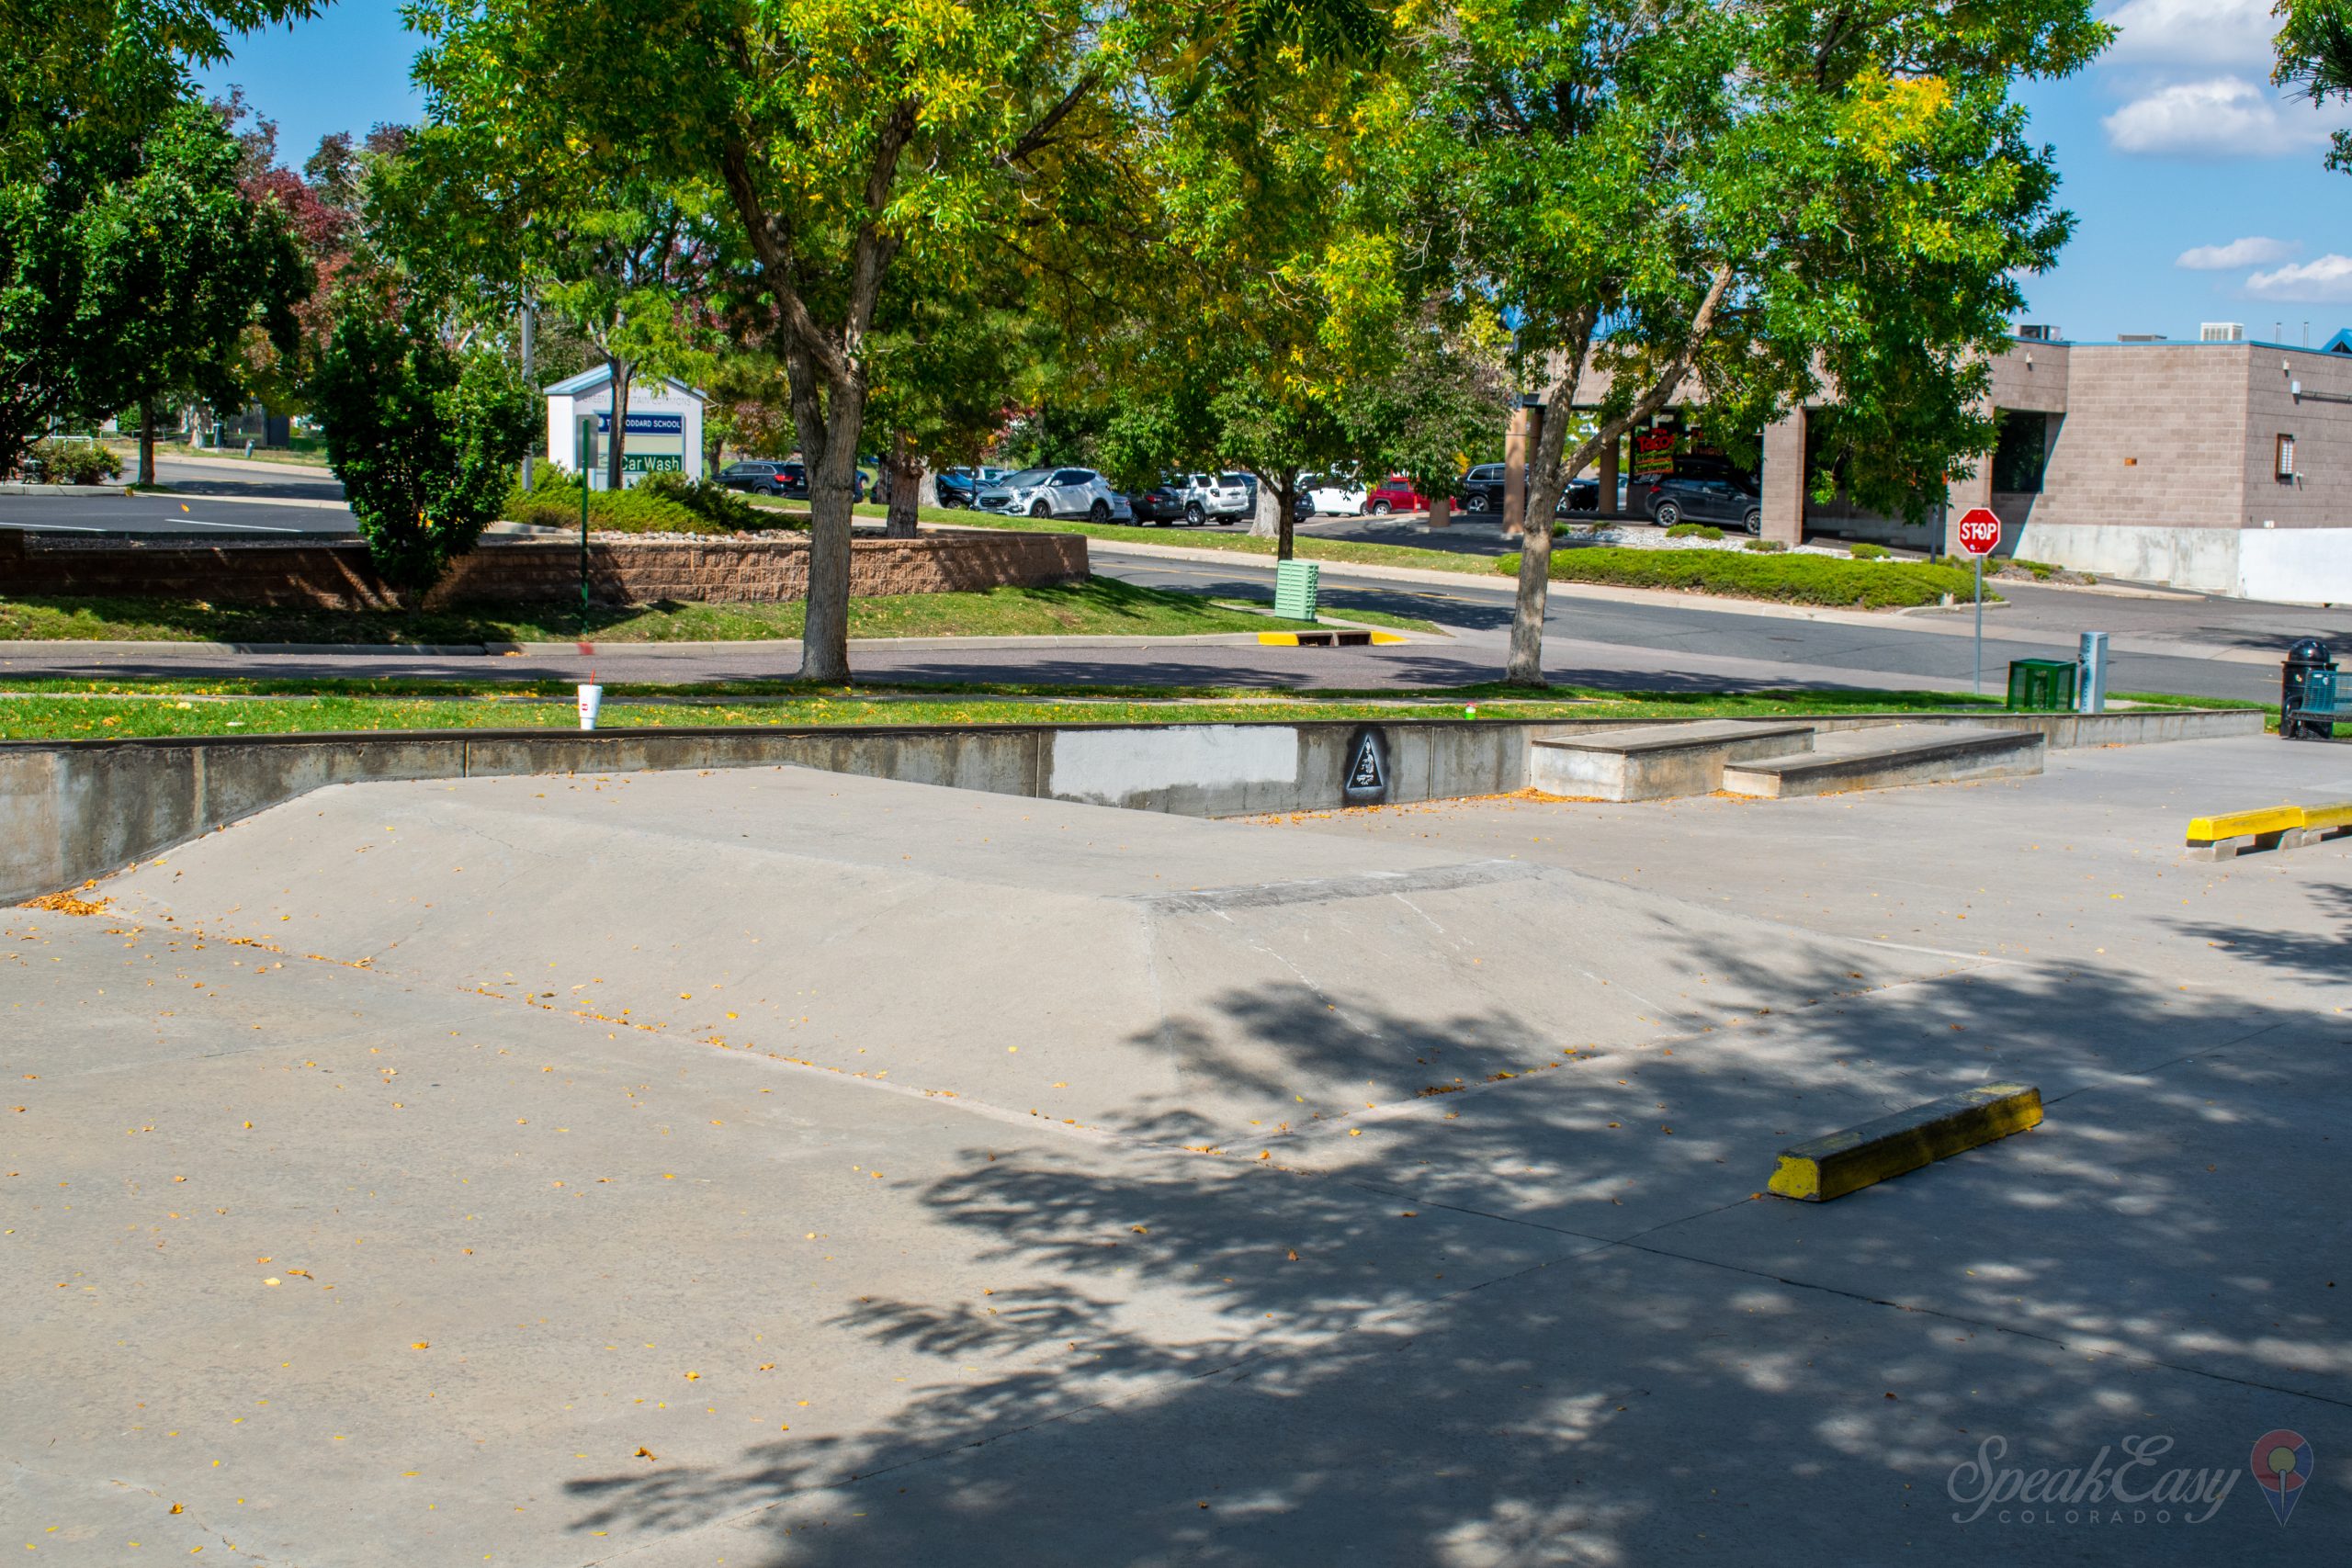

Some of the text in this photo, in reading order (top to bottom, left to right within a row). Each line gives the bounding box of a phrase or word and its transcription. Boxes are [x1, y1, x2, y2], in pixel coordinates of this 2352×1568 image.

[582, 395, 608, 403] GREEN
[651, 397, 691, 406] COMMONS
[625, 419, 652, 428] ODDARD
[653, 420, 681, 429] SCHOOL
[622, 456, 679, 471] Car Wash
[1961, 522, 1997, 540] STOP
